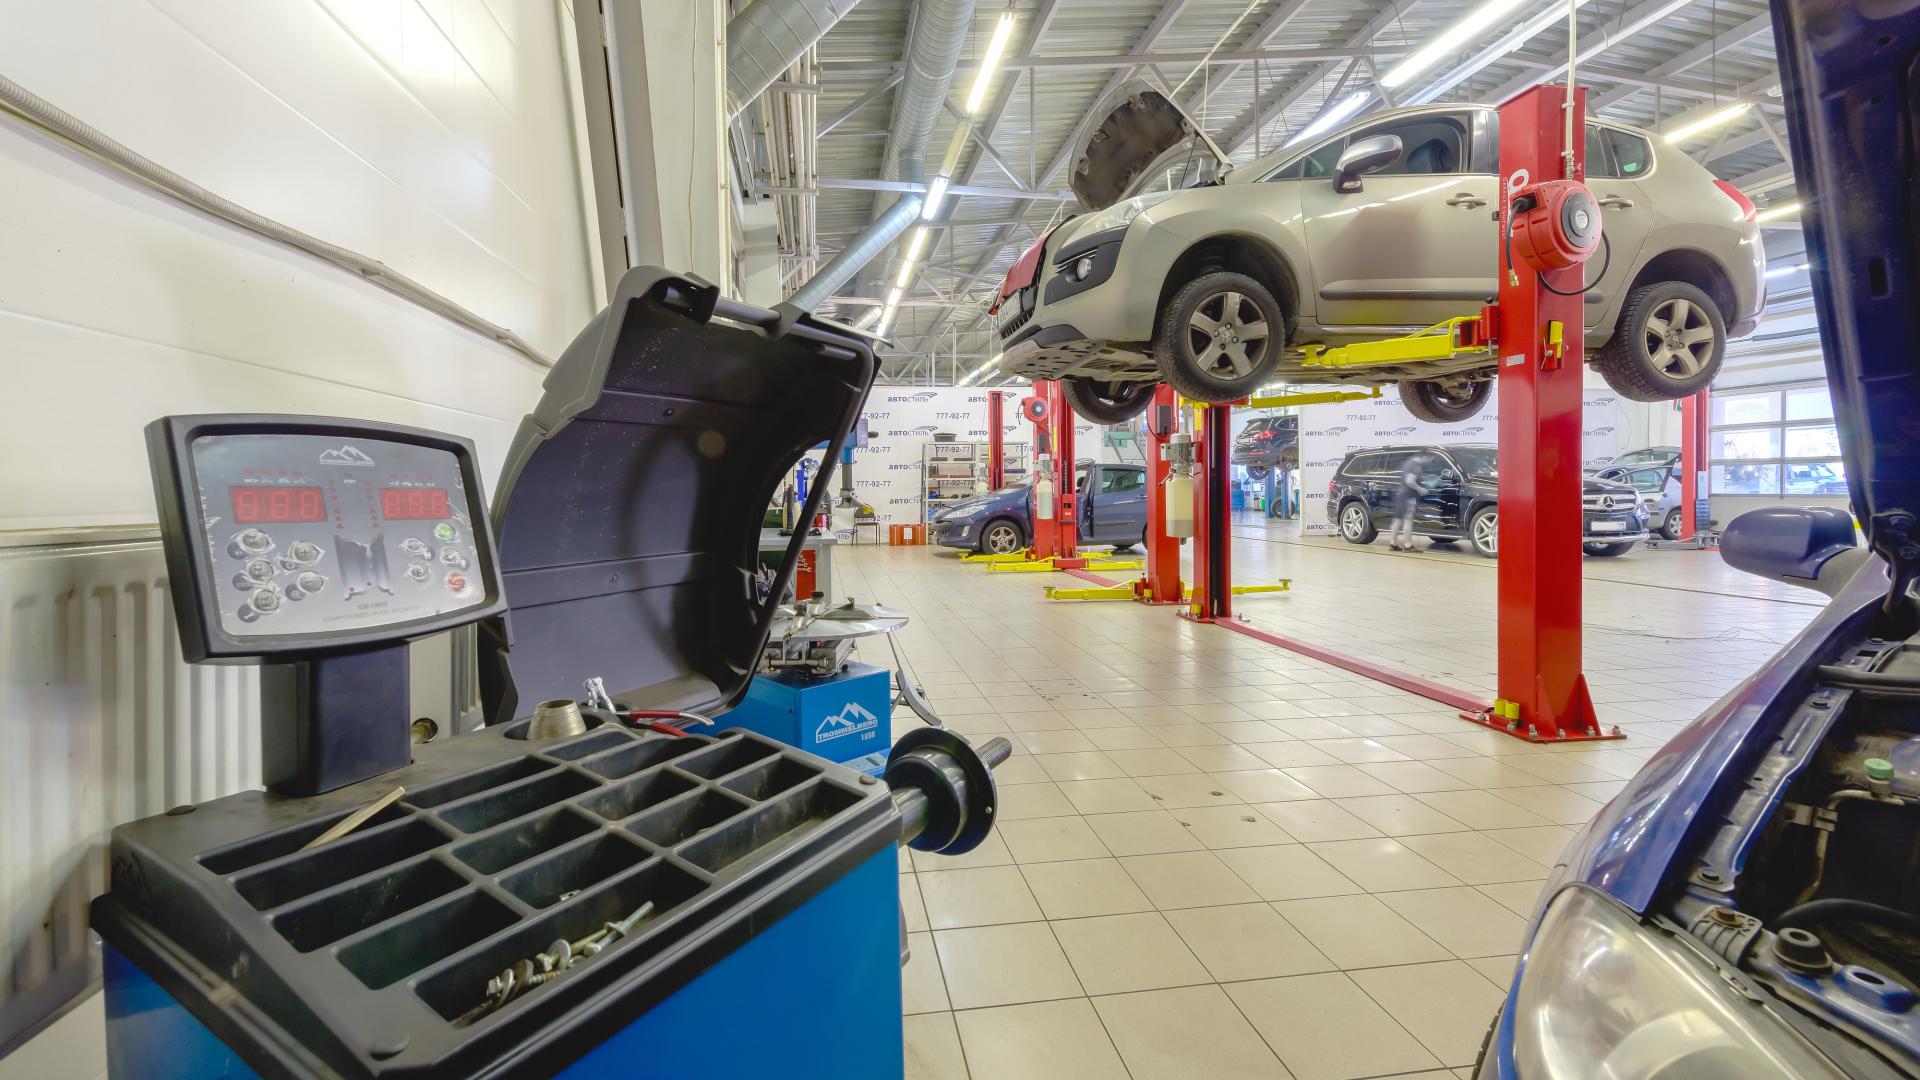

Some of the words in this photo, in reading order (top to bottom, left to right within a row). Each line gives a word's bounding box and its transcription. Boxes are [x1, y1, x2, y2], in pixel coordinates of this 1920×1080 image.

[935, 412, 971, 420] 777-92-77
[856, 480, 891, 488] 777-92-77
[817, 719, 878, 741] TROMMELBERG
